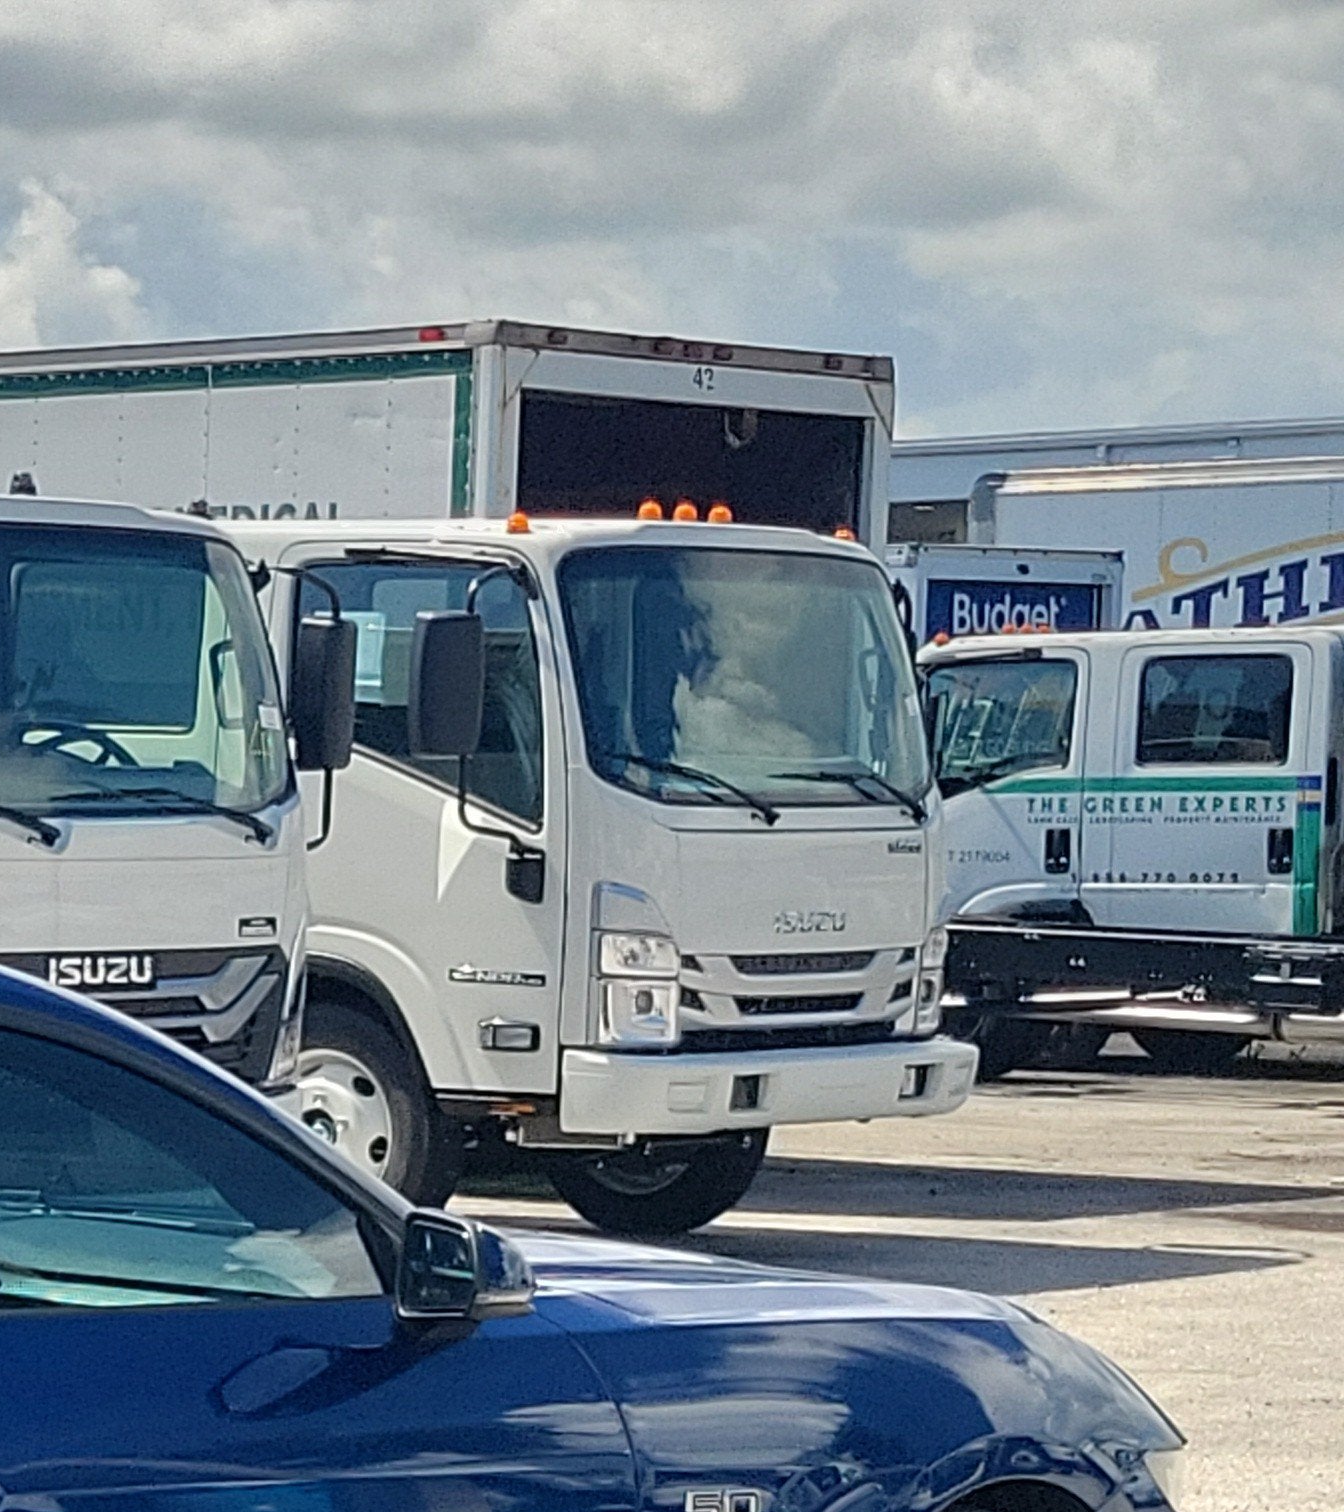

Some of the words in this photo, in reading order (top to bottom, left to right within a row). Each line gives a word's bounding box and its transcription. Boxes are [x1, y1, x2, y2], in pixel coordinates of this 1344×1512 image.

[693, 367, 714, 390] 42
[952, 591, 1060, 636] Budget
[1027, 797, 1068, 814] THE
[1083, 796, 1163, 813] GREEN
[1179, 796, 1287, 813] EXPERTS
[773, 910, 847, 935] ISUZU
[48, 955, 154, 986] ISUZU
